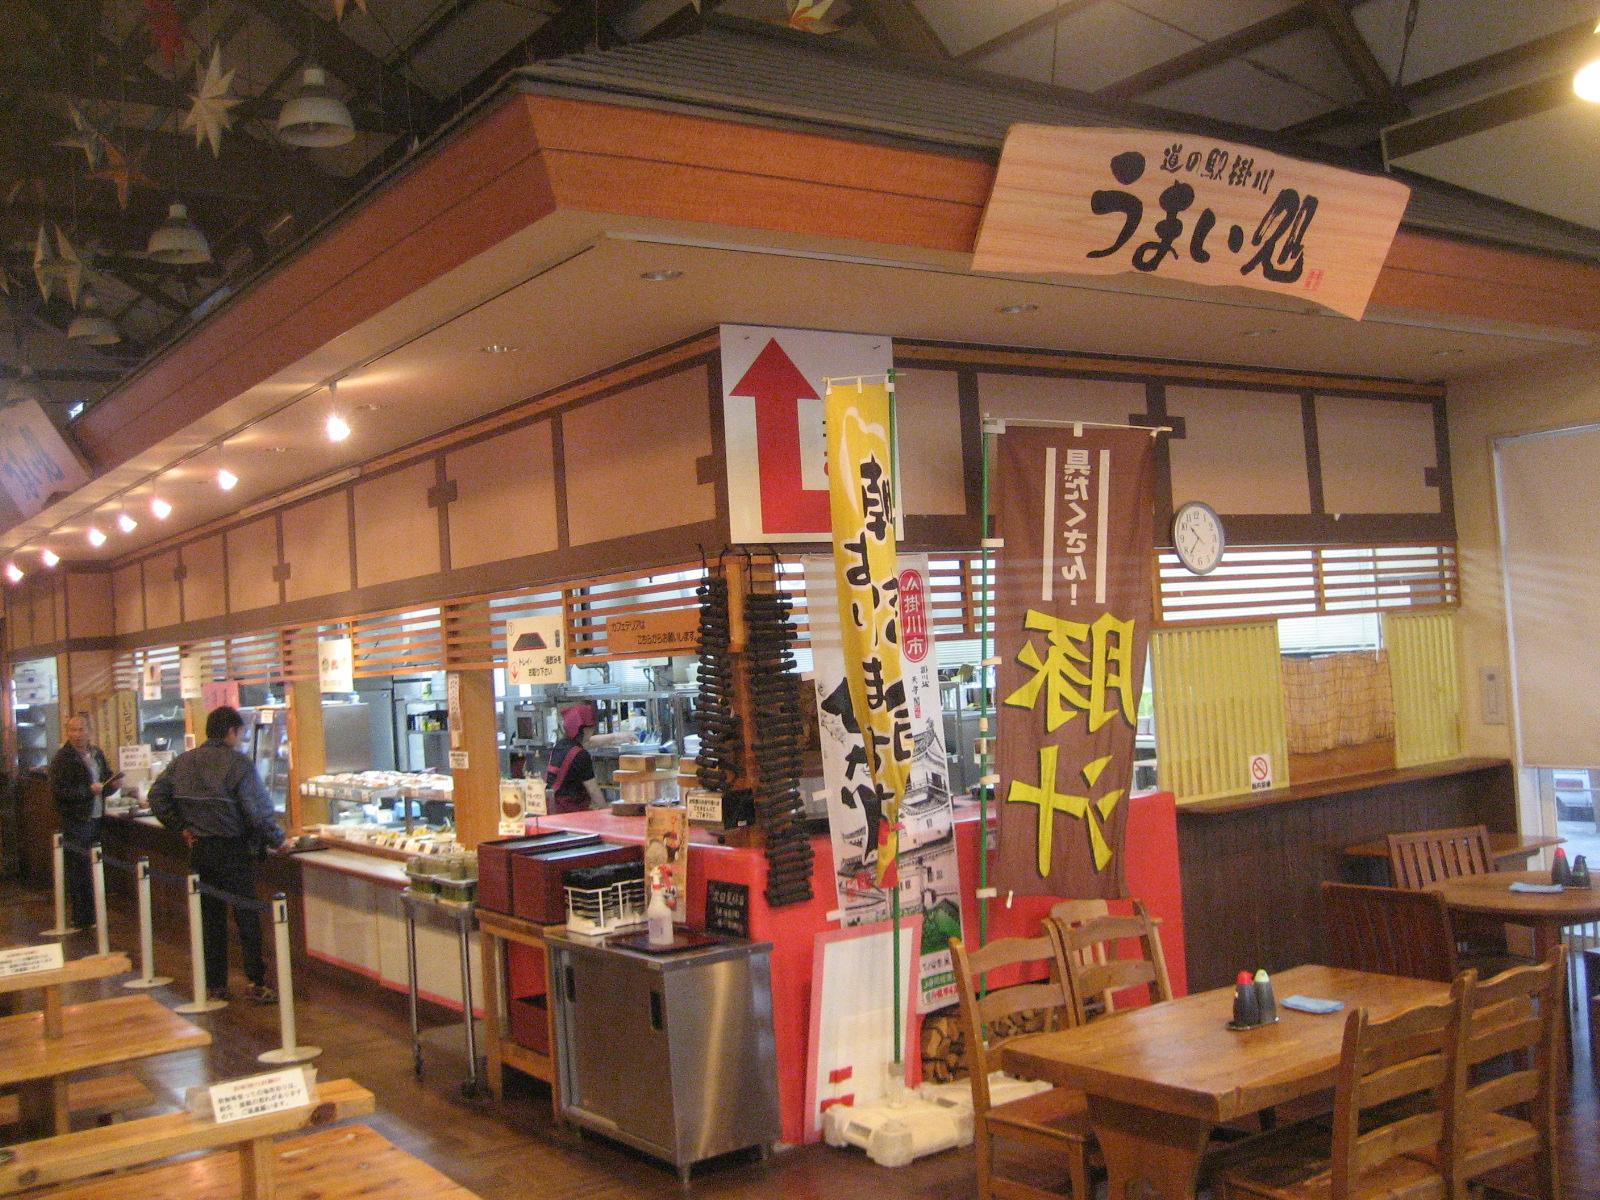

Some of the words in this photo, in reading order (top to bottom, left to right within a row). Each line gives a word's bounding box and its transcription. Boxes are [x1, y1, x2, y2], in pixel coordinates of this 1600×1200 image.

[1160, 143, 1276, 195] 道の駅掛川
[1085, 151, 1320, 284] うまい処
